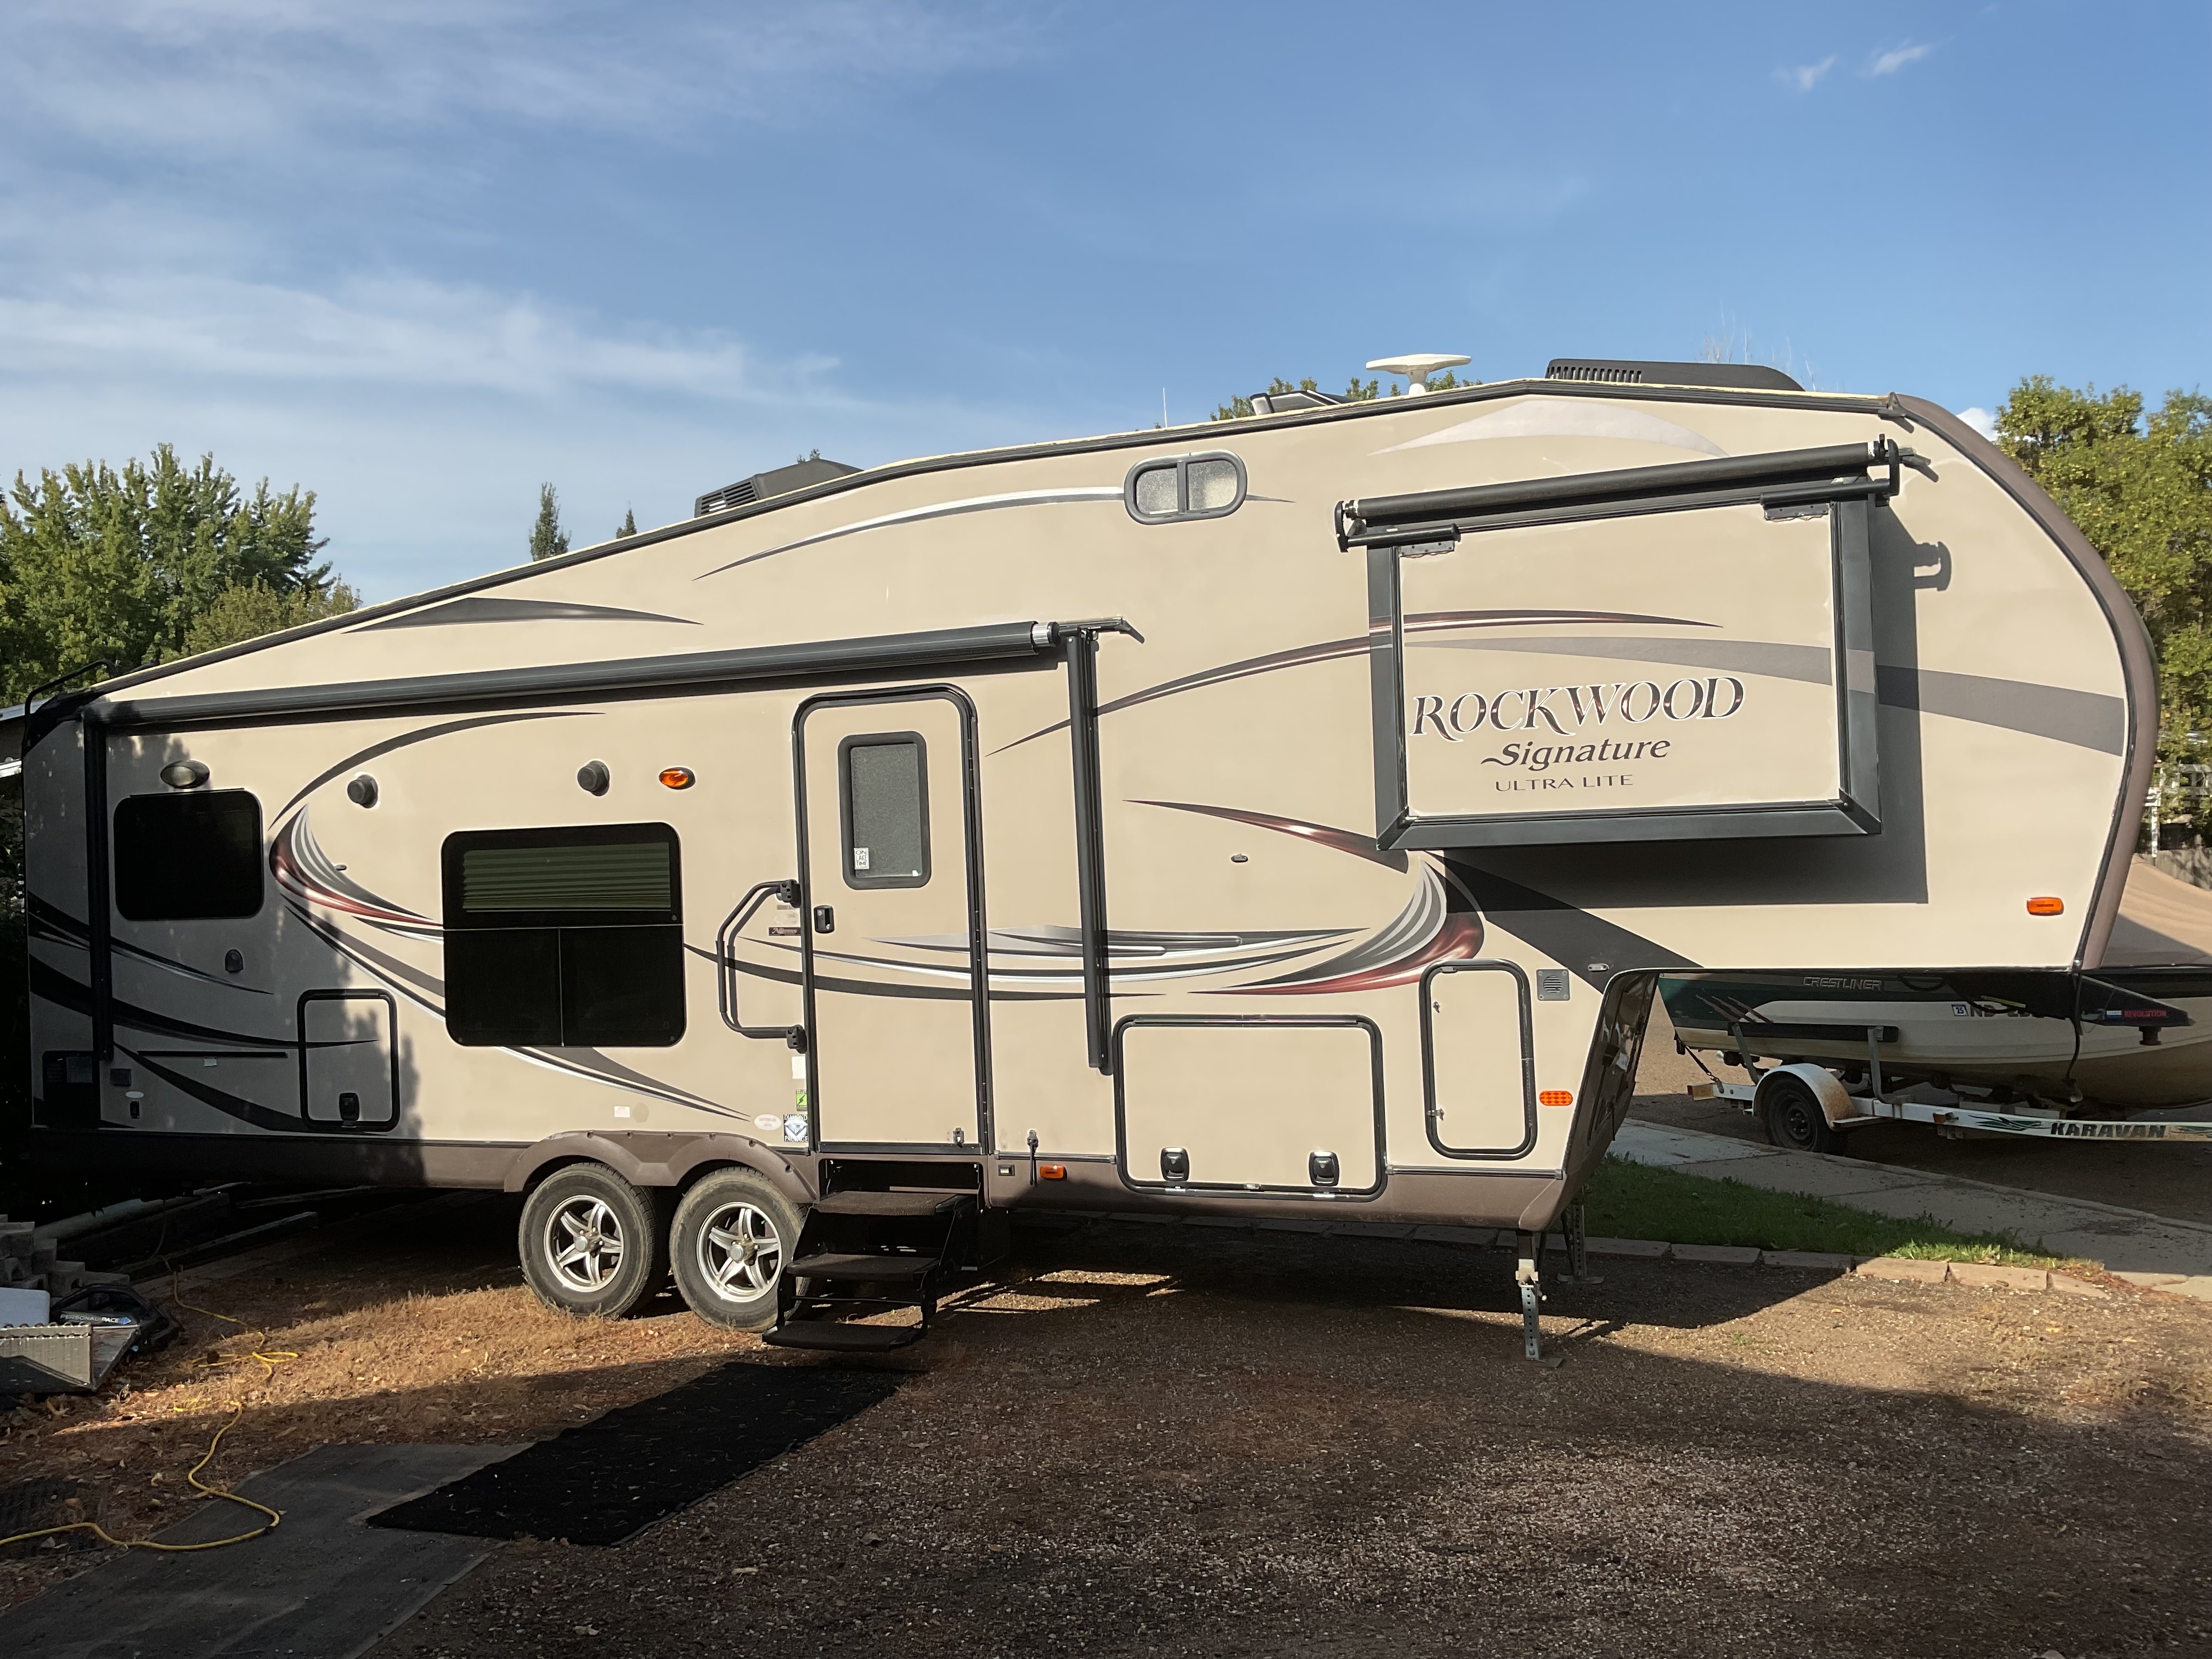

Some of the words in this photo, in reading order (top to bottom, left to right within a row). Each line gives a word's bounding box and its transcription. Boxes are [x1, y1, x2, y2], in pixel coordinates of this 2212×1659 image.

[1409, 676, 1745, 742] ROCKWOOD
[1481, 738, 1671, 771] Signature
[1496, 777, 1574, 792] ULTRA
[1583, 774, 1633, 787] LITE
[1803, 977, 1883, 991] CRESTLINER
[2050, 1122, 2167, 1138] KARAVAN
